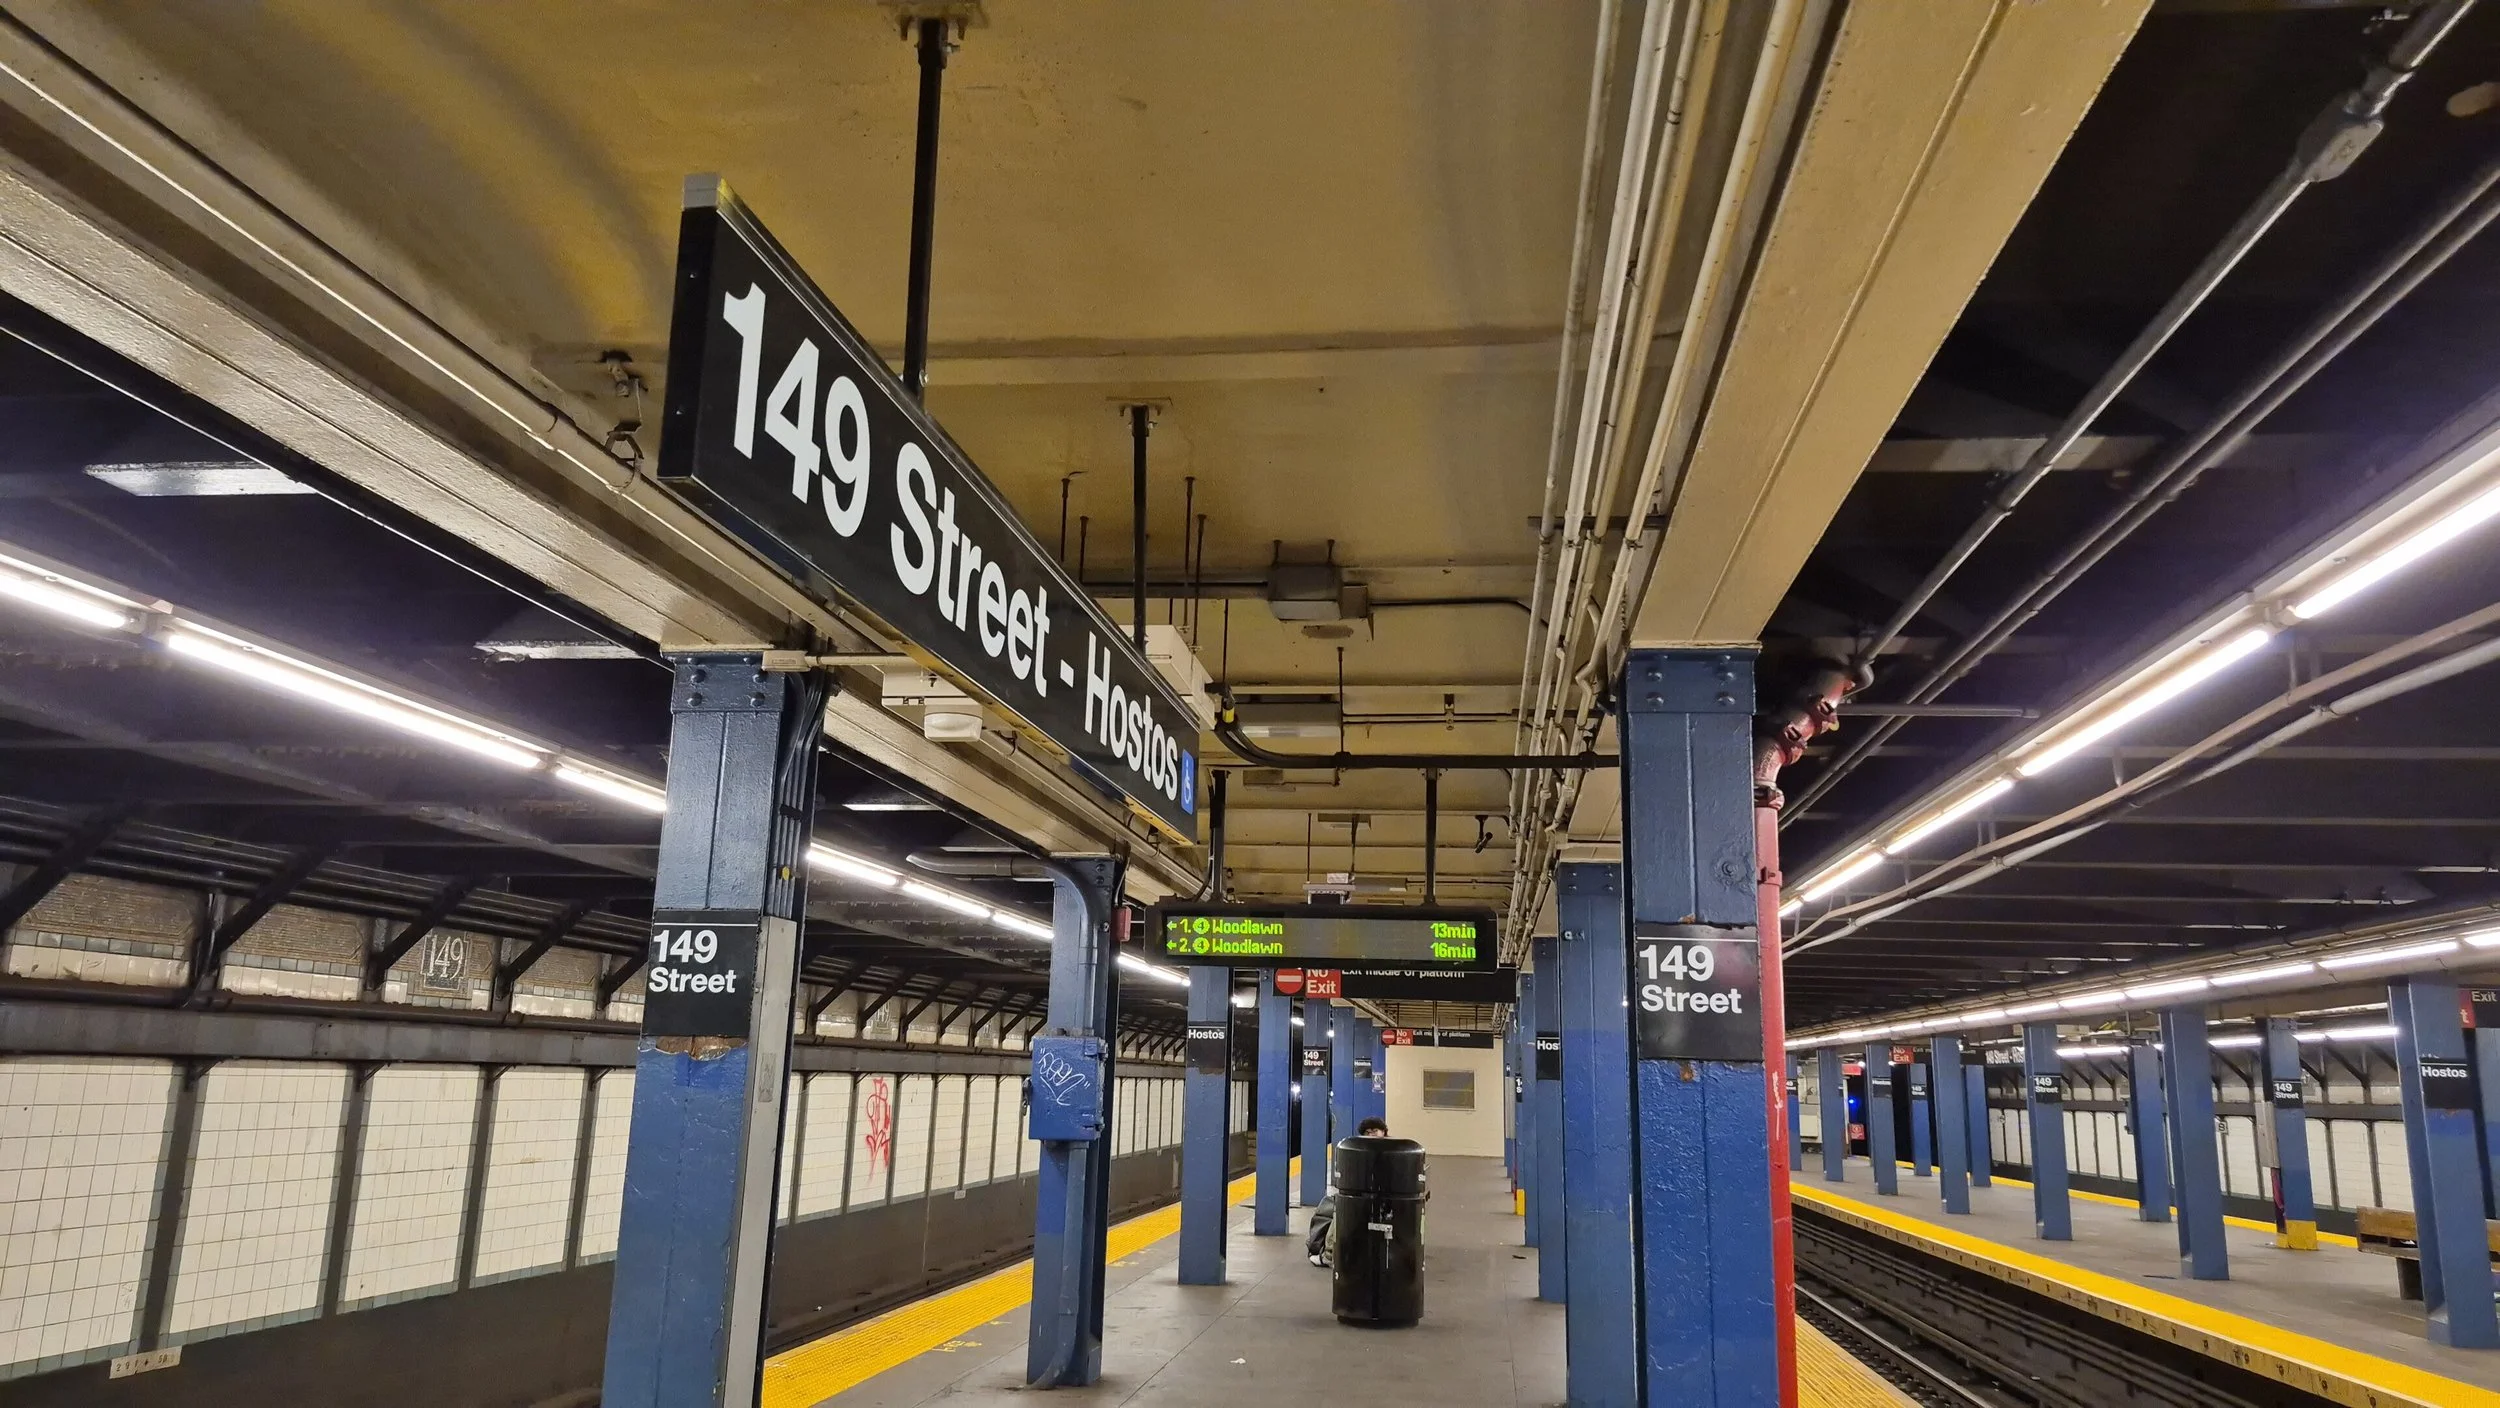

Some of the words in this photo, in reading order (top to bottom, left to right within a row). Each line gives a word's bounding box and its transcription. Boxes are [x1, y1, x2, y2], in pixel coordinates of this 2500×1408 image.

[723, 282, 870, 537] 149
[890, 442, 1050, 697] Street
[1084, 632, 1177, 800] Hostos
[1212, 919, 1283, 934] Woodlawn
[1430, 923, 1476, 939] 13min
[653, 930, 718, 963] 149
[1212, 938, 1283, 954] Woodlawn
[1430, 943, 1476, 959] 16min
[427, 934, 463, 979] 149
[1639, 944, 1714, 981] 149
[648, 967, 736, 993] Street
[1307, 980, 1336, 994] Exit
[1641, 984, 1742, 1014] Street
[2471, 990, 2497, 1002] Exit
[1188, 1028, 1225, 1040] Hostos
[1537, 1040, 1560, 1050] Hos
[1303, 1051, 1319, 1060] 149
[1893, 1053, 1909, 1062] Exit
[2421, 1066, 2468, 1078] Hostos
[2034, 1077, 2052, 1086] 149
[2274, 1083, 2293, 1092] 149
[2275, 1091, 2299, 1099] Street
